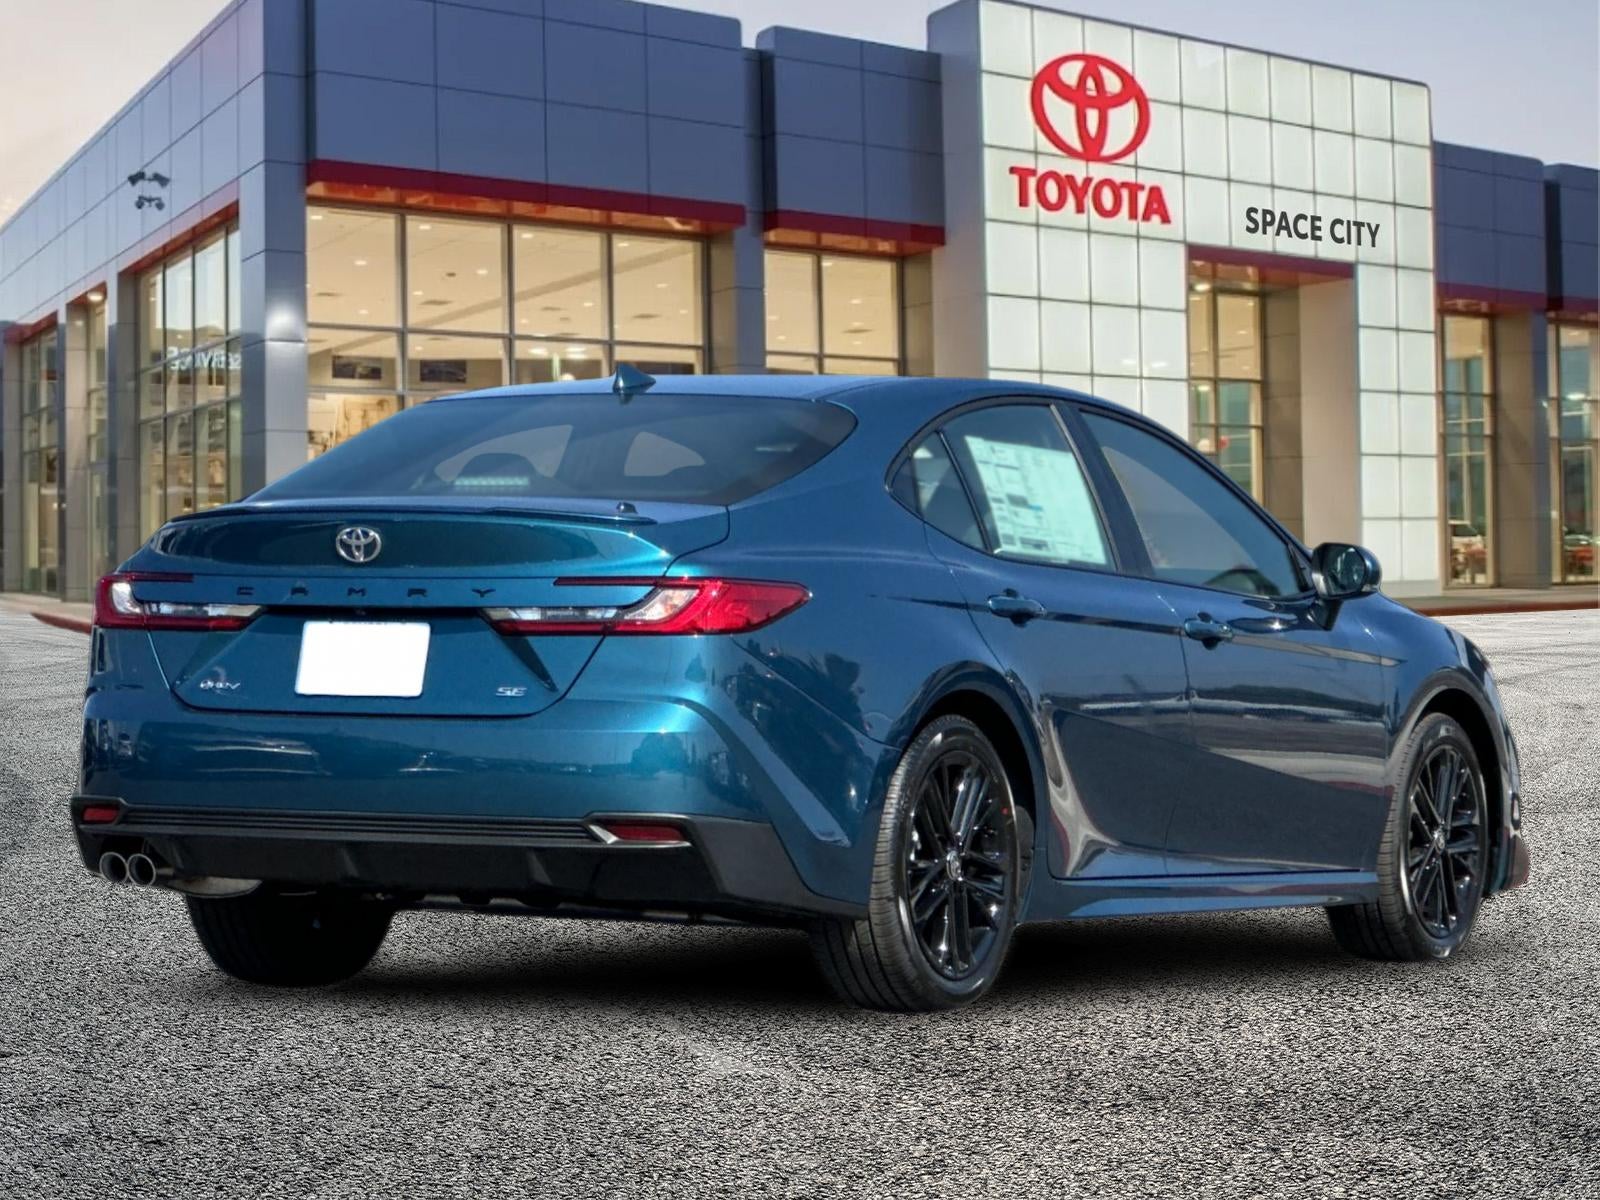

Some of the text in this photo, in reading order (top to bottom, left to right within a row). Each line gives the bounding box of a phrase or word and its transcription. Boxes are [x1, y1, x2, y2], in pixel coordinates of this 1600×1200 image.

[1009, 166, 1171, 225] TOYOTA
[1245, 206, 1381, 248] SPACE CITY
[236, 586, 496, 598] CAMRY
[495, 686, 528, 697] SE
